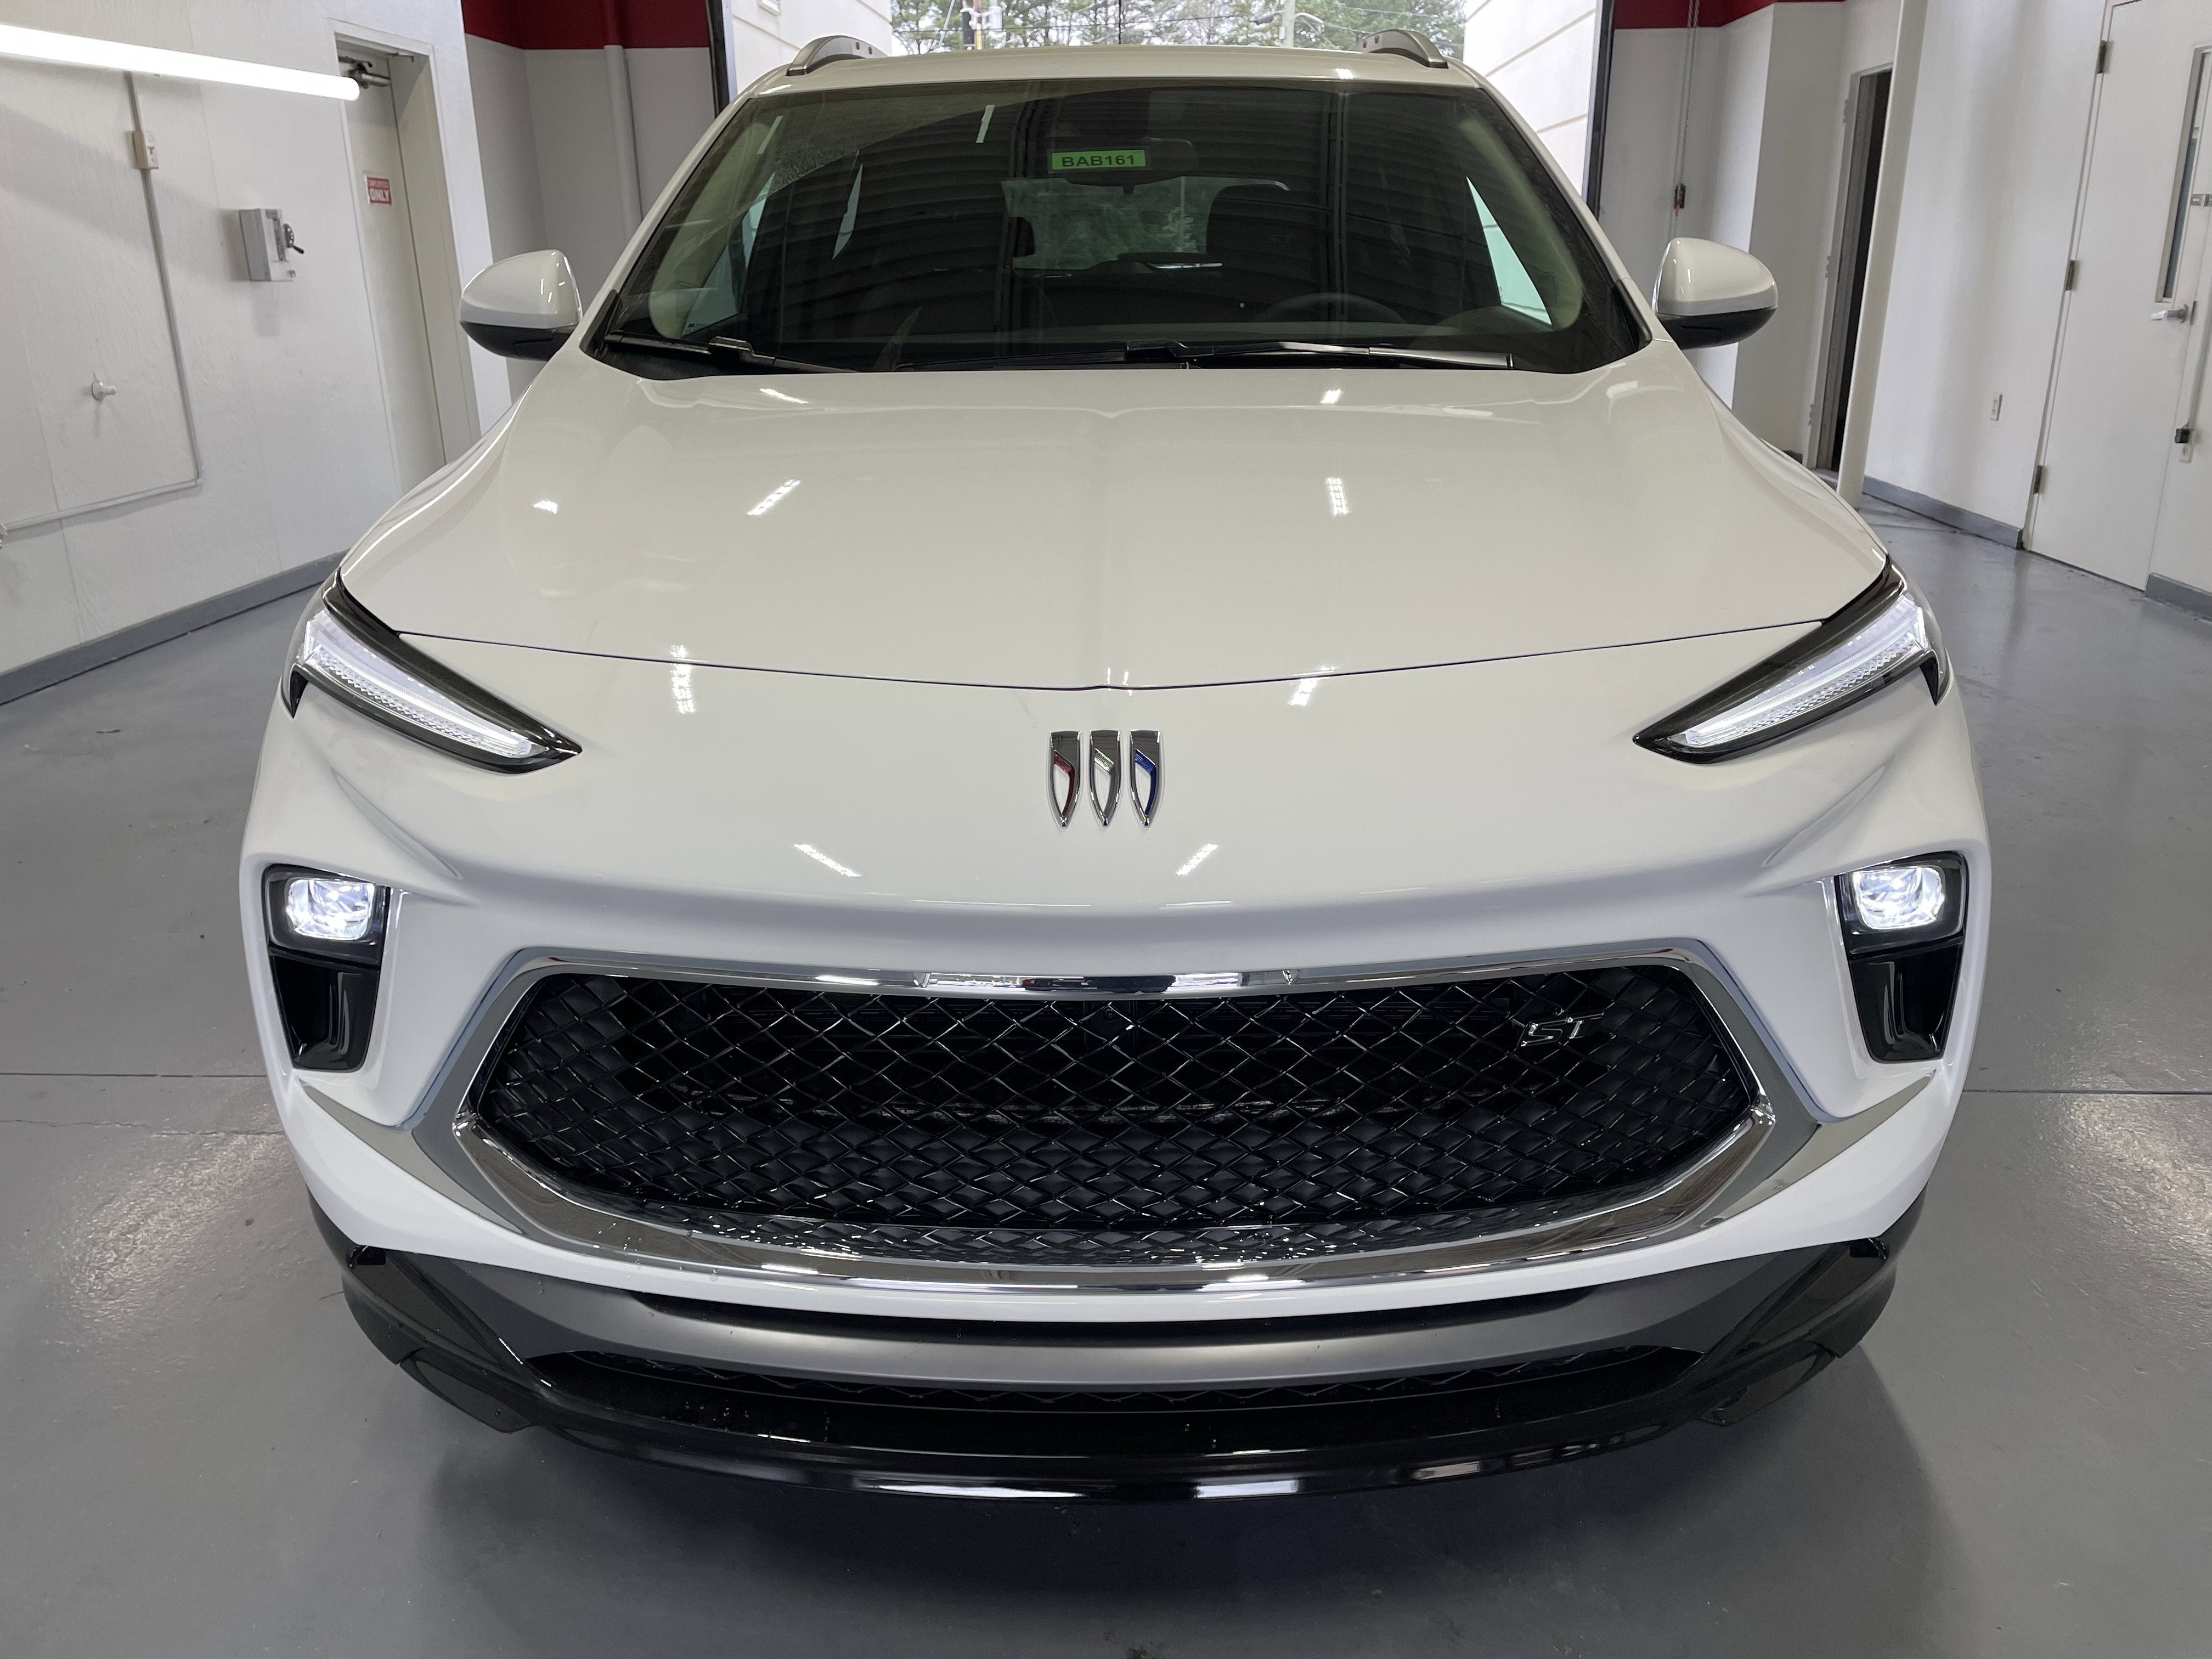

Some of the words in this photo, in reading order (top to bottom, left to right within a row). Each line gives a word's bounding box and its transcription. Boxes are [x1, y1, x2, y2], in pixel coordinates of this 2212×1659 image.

[1062, 155, 1135, 167] BAB161
[369, 188, 390, 202] ONLY
[1520, 1012, 1604, 1047] ST
